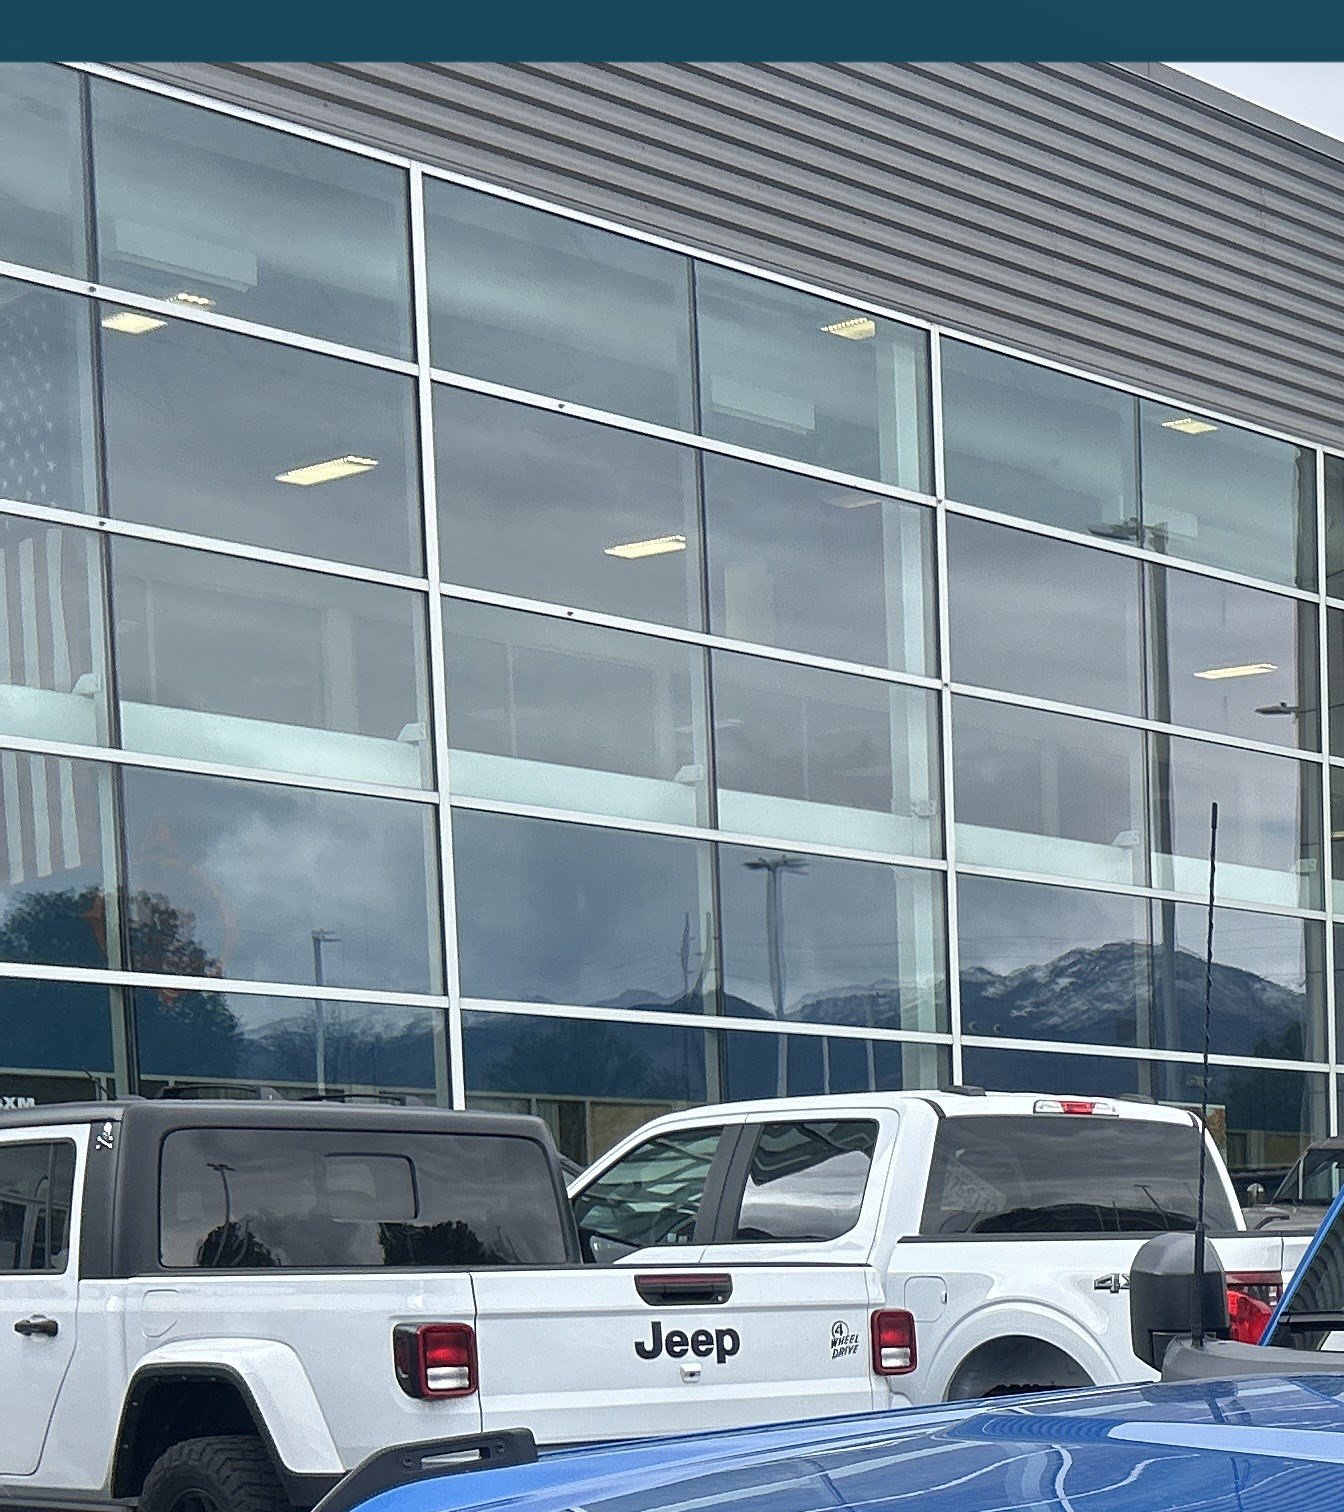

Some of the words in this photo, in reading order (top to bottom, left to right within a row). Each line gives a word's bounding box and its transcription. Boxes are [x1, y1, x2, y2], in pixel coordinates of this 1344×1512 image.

[634, 1321, 740, 1364] Jeep
[831, 1334, 859, 1349] WHEEL
[831, 1344, 859, 1360] DRIVE
